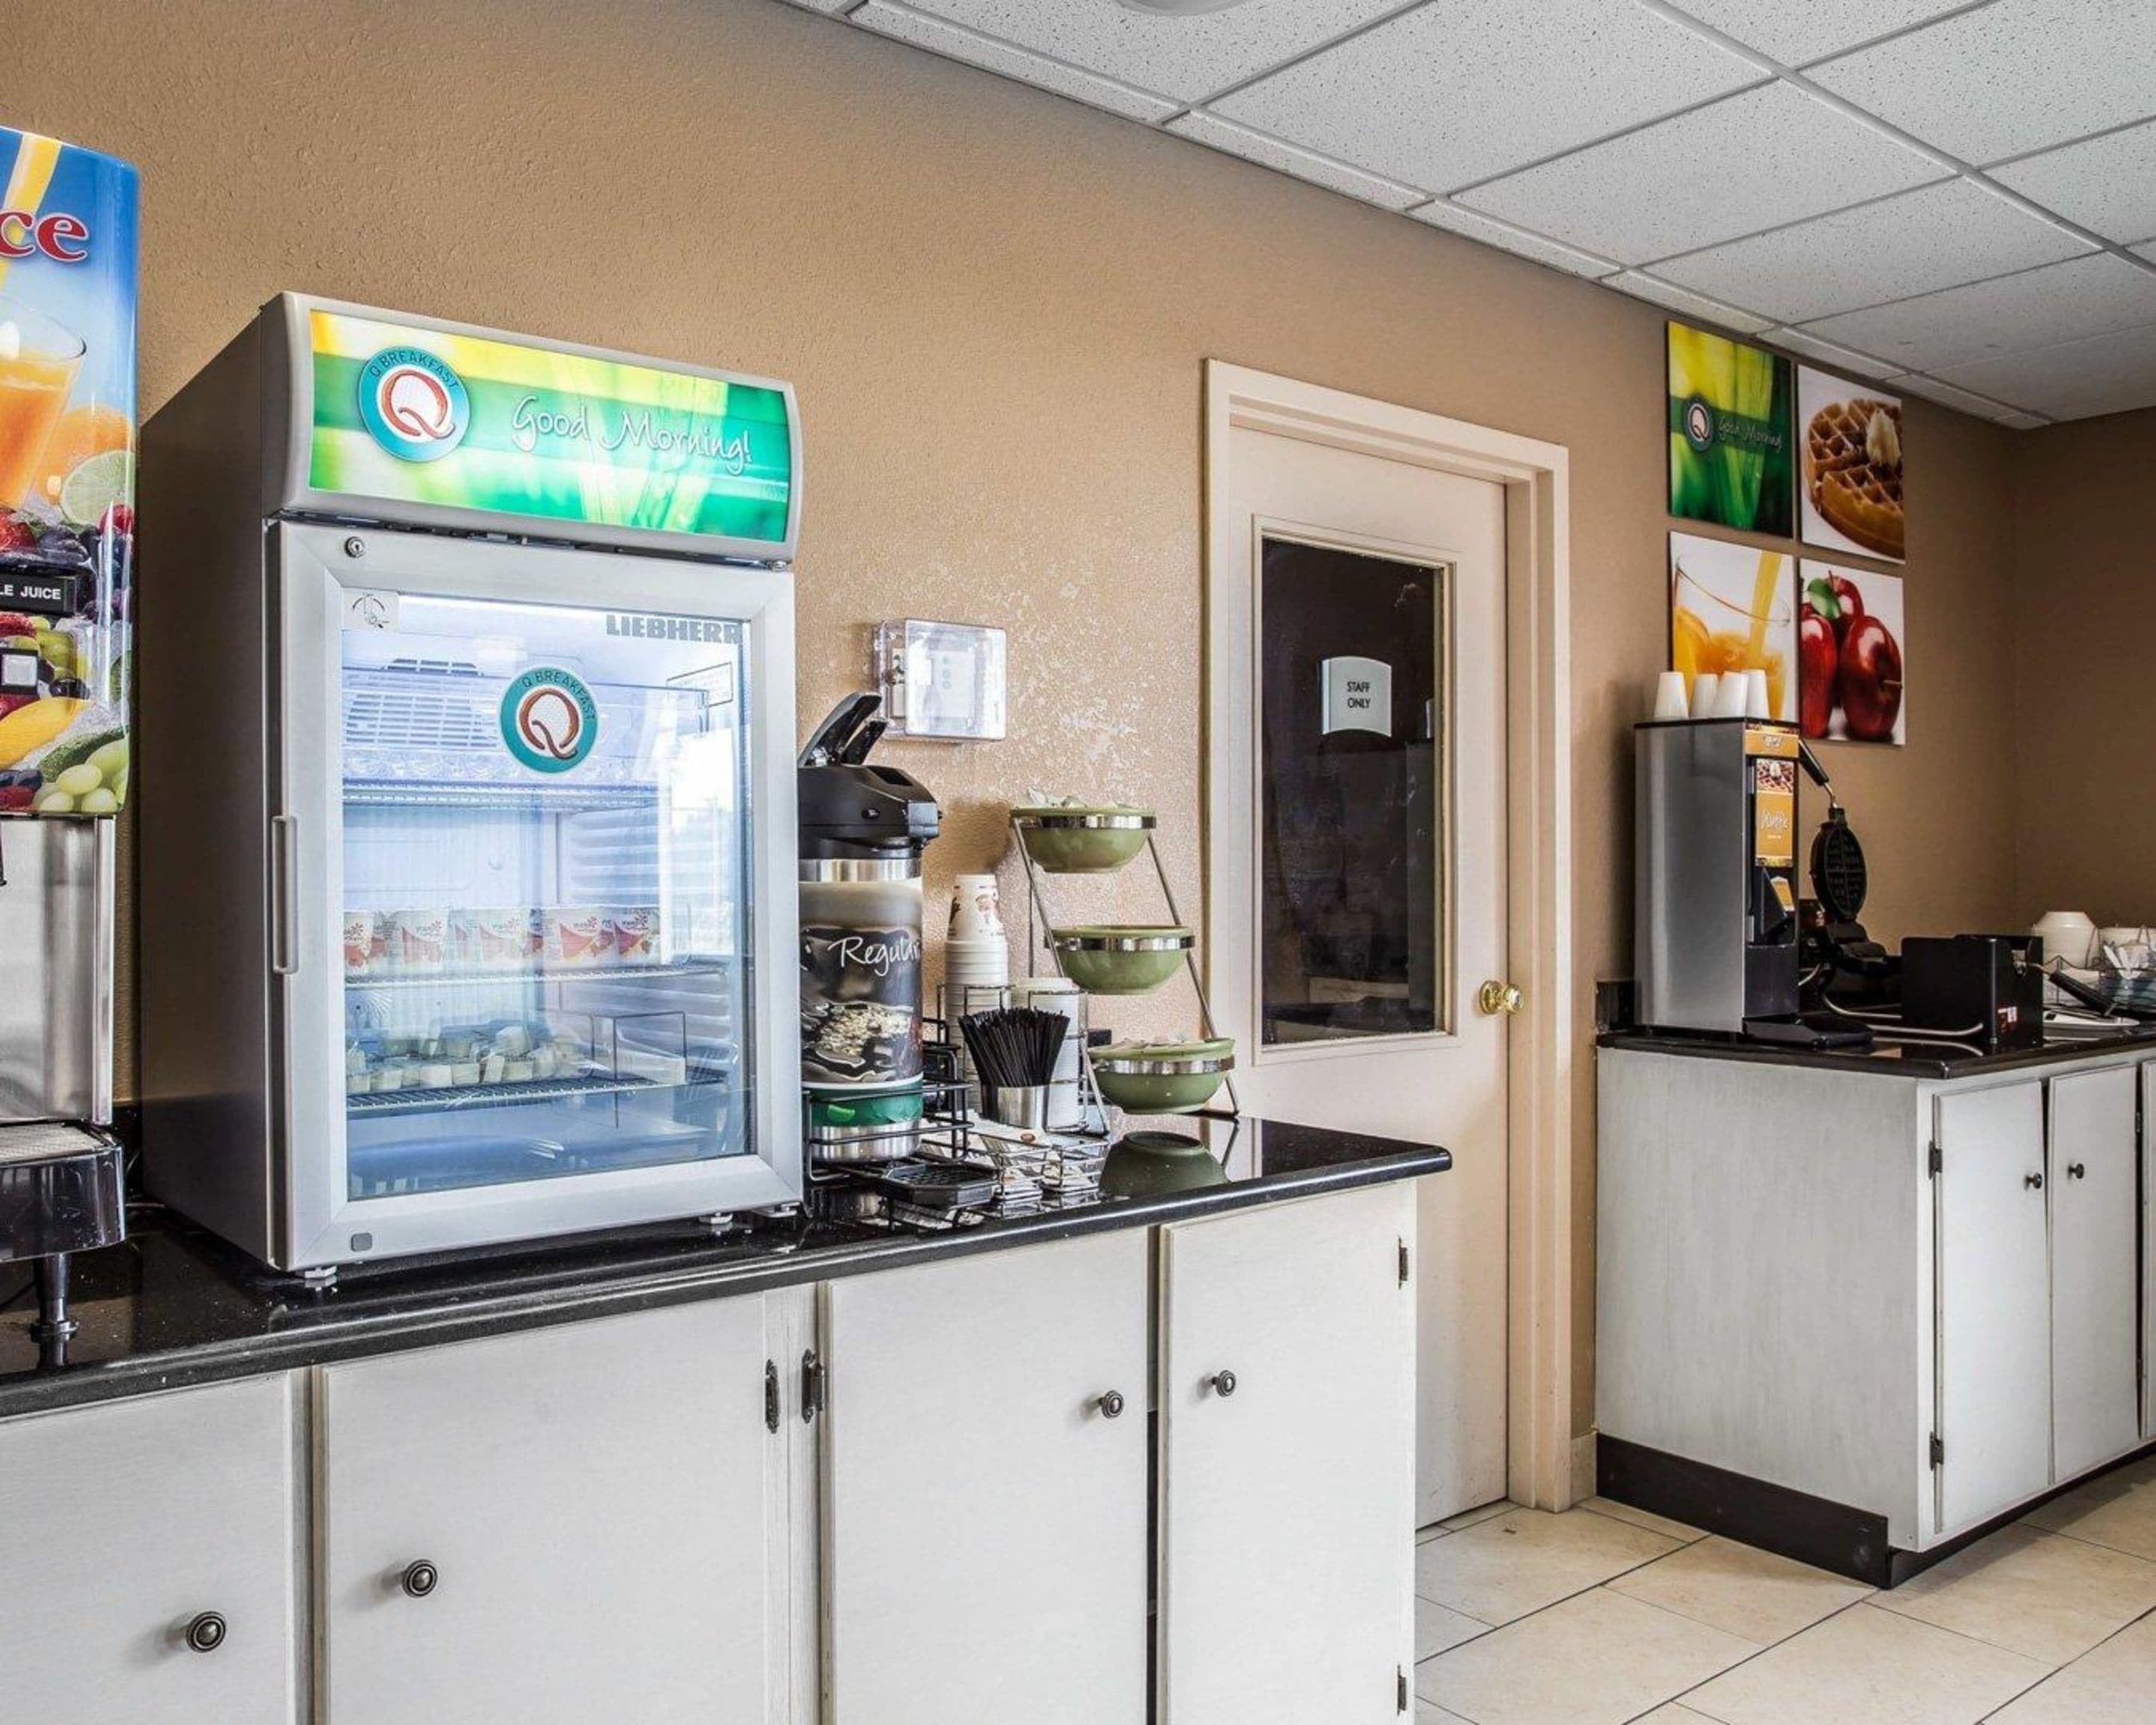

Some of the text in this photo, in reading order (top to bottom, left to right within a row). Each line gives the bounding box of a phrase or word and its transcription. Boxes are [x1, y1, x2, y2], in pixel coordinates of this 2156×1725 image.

[380, 351, 459, 389] BREAKFAST
[381, 370, 457, 439] Q
[512, 395, 752, 475] Good Morning!
[20, 585, 61, 600] JUICE
[606, 614, 743, 644] LIEBHERR
[522, 670, 596, 719] Q BREAKFAST
[1347, 681, 1371, 693] STAFF
[1347, 698, 1371, 708] ONLY
[519, 688, 579, 760] Q
